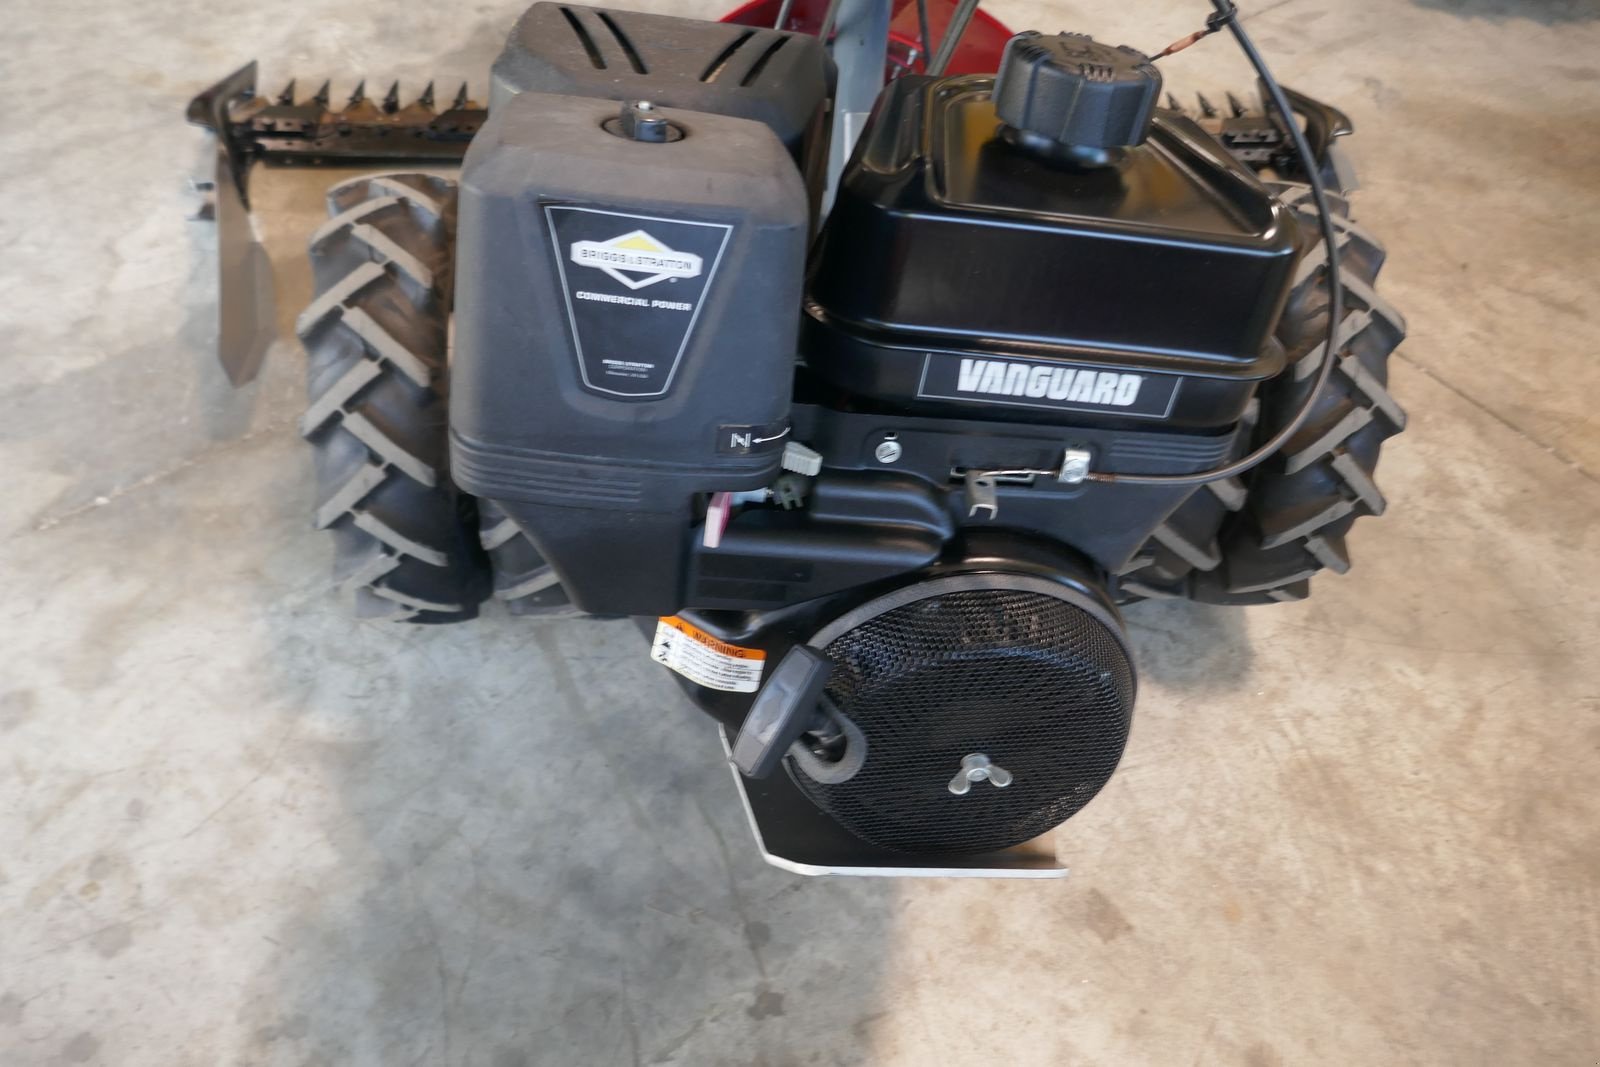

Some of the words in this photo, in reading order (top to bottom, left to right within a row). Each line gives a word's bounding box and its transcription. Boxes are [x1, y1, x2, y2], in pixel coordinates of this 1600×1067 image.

[581, 249, 626, 262] BRIGGS
[637, 256, 692, 269] STRATTON
[576, 291, 650, 307] COMMERCIAL
[651, 300, 692, 311] POWER
[957, 359, 1142, 406] VANGUARD
[692, 630, 745, 658] WARNING
